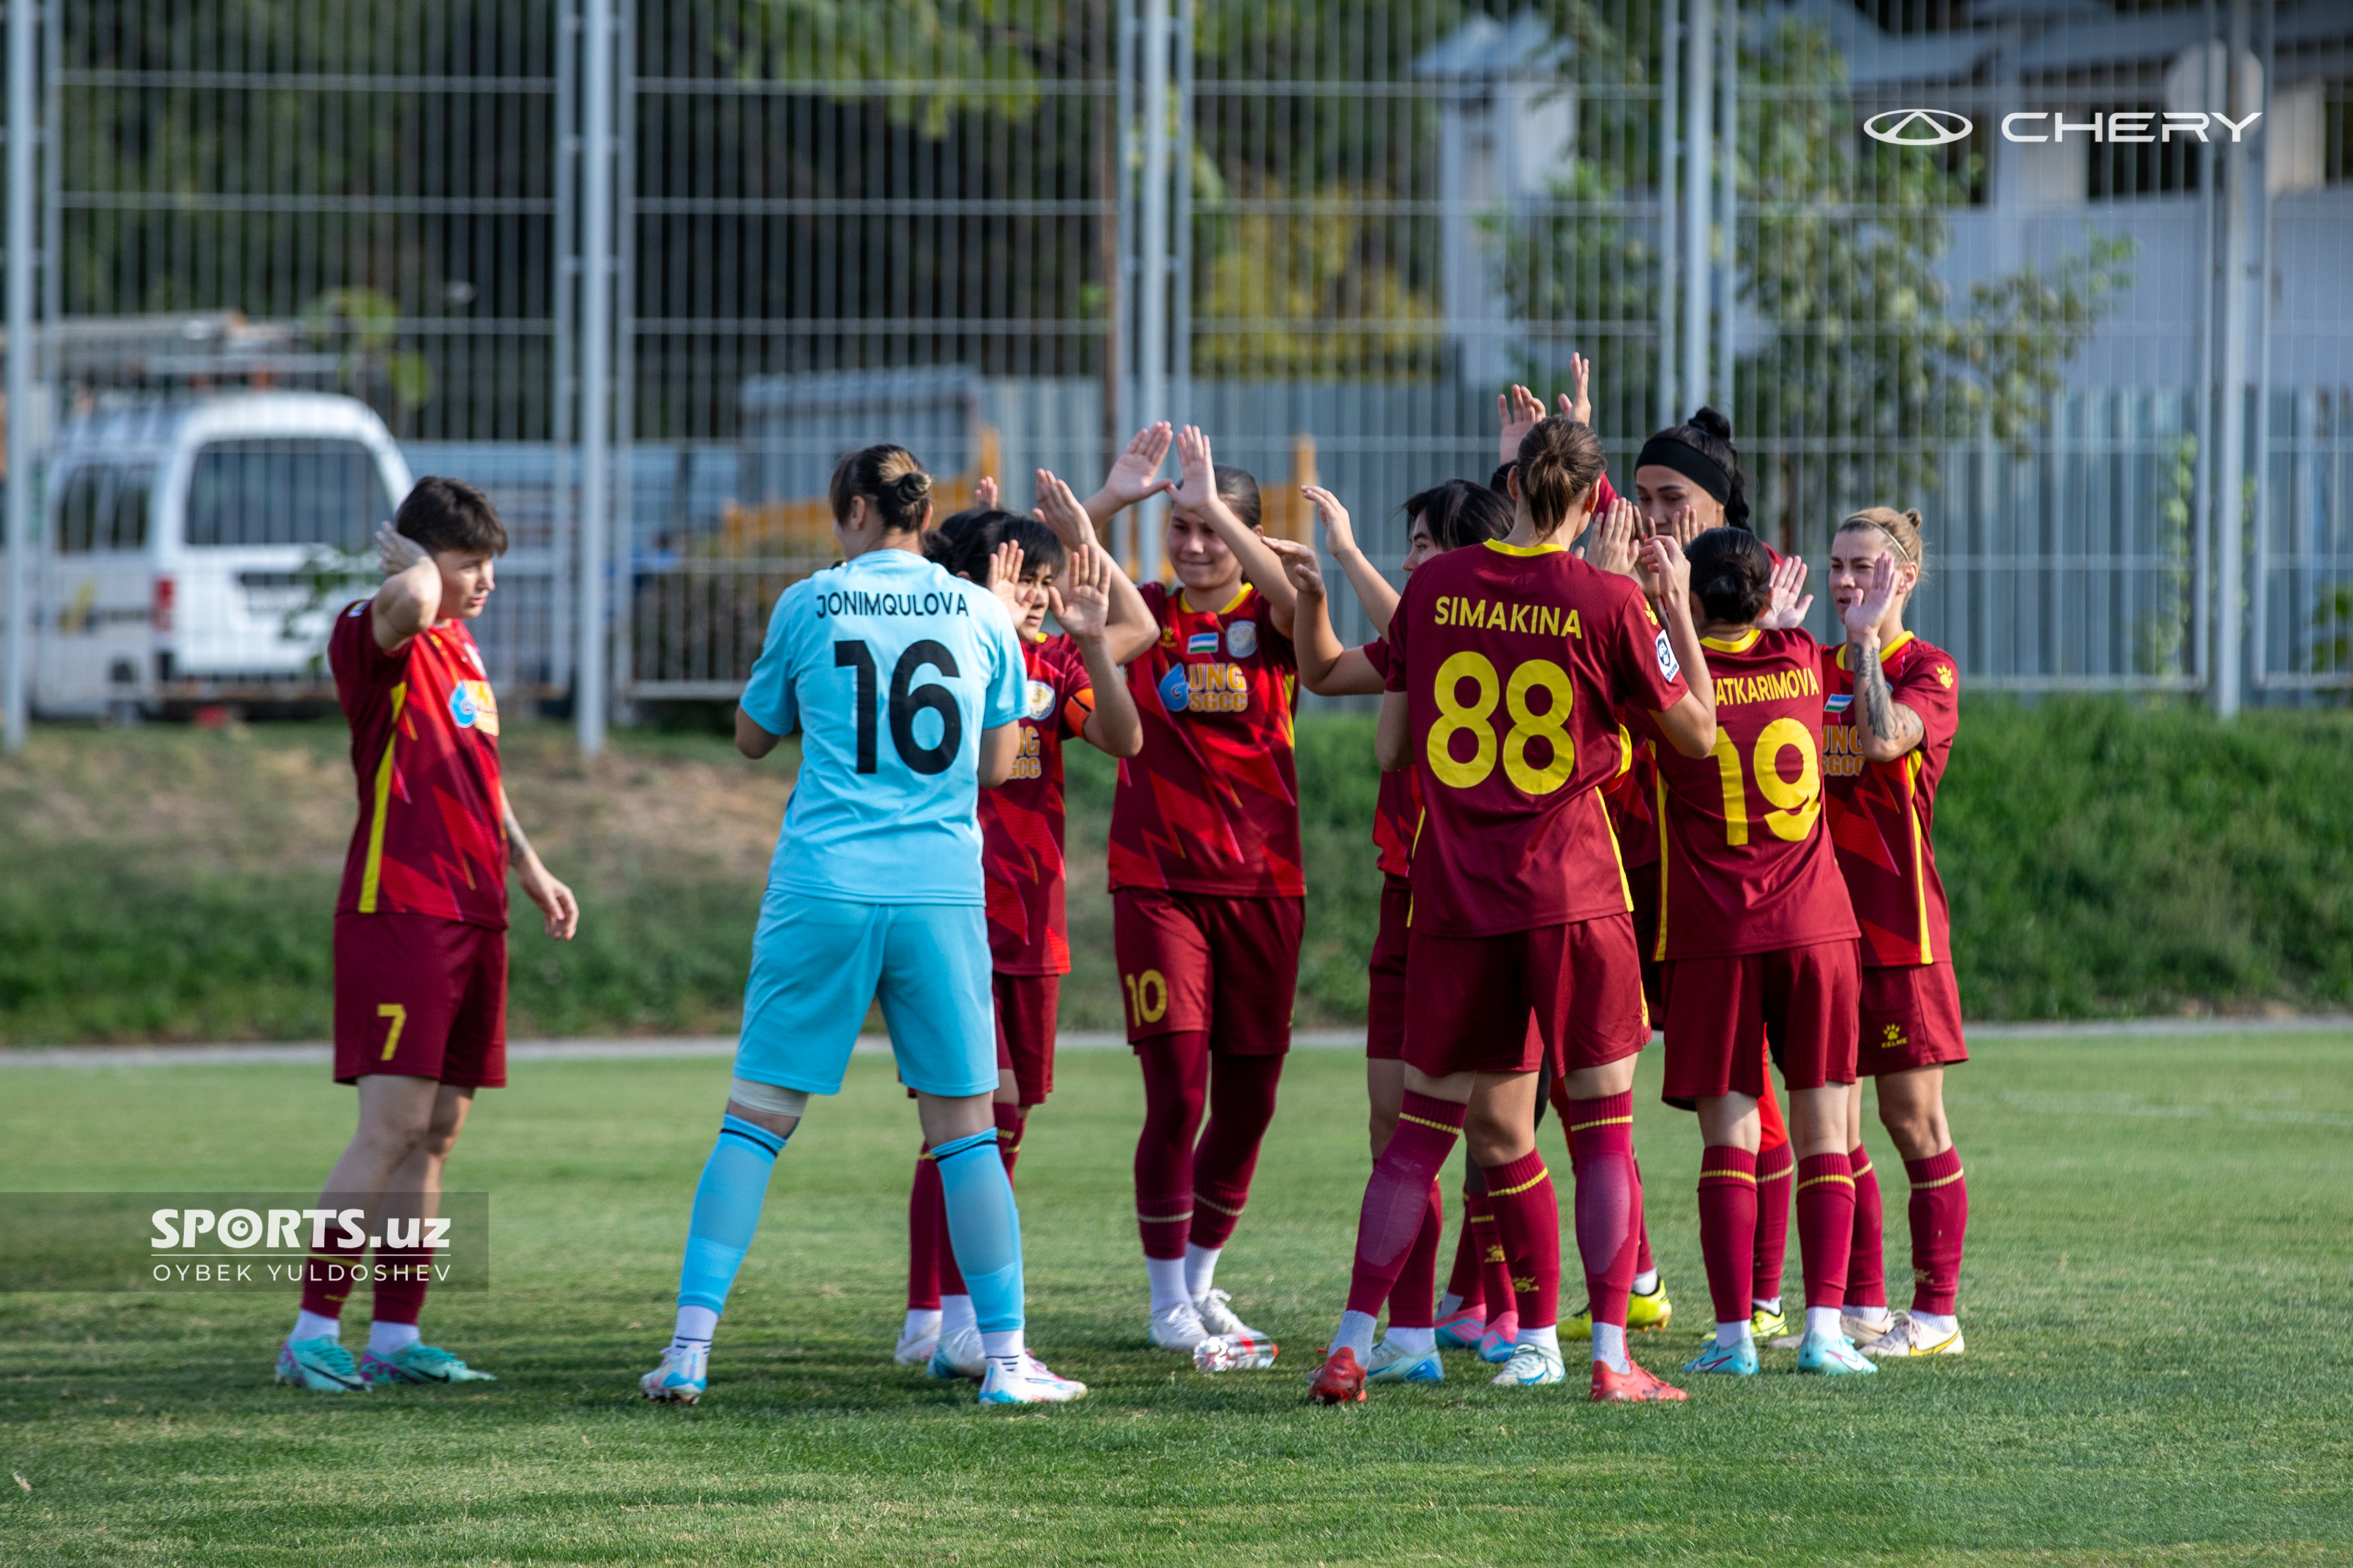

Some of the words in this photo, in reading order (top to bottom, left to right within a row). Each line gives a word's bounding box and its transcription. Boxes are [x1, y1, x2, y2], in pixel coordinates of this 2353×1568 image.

[816, 590, 970, 619] JONIMQULOVA
[1434, 595, 1583, 640] SIMAKINA
[1188, 663, 1247, 692] UNG
[1188, 691, 1249, 712] SGCC
[1711, 667, 1820, 707] ATKARIMOVA
[834, 639, 962, 775] 16
[1427, 650, 1575, 795] 88
[1709, 717, 1821, 847] 19
[1125, 969, 1168, 1027] 10
[377, 1003, 408, 1061] 7
